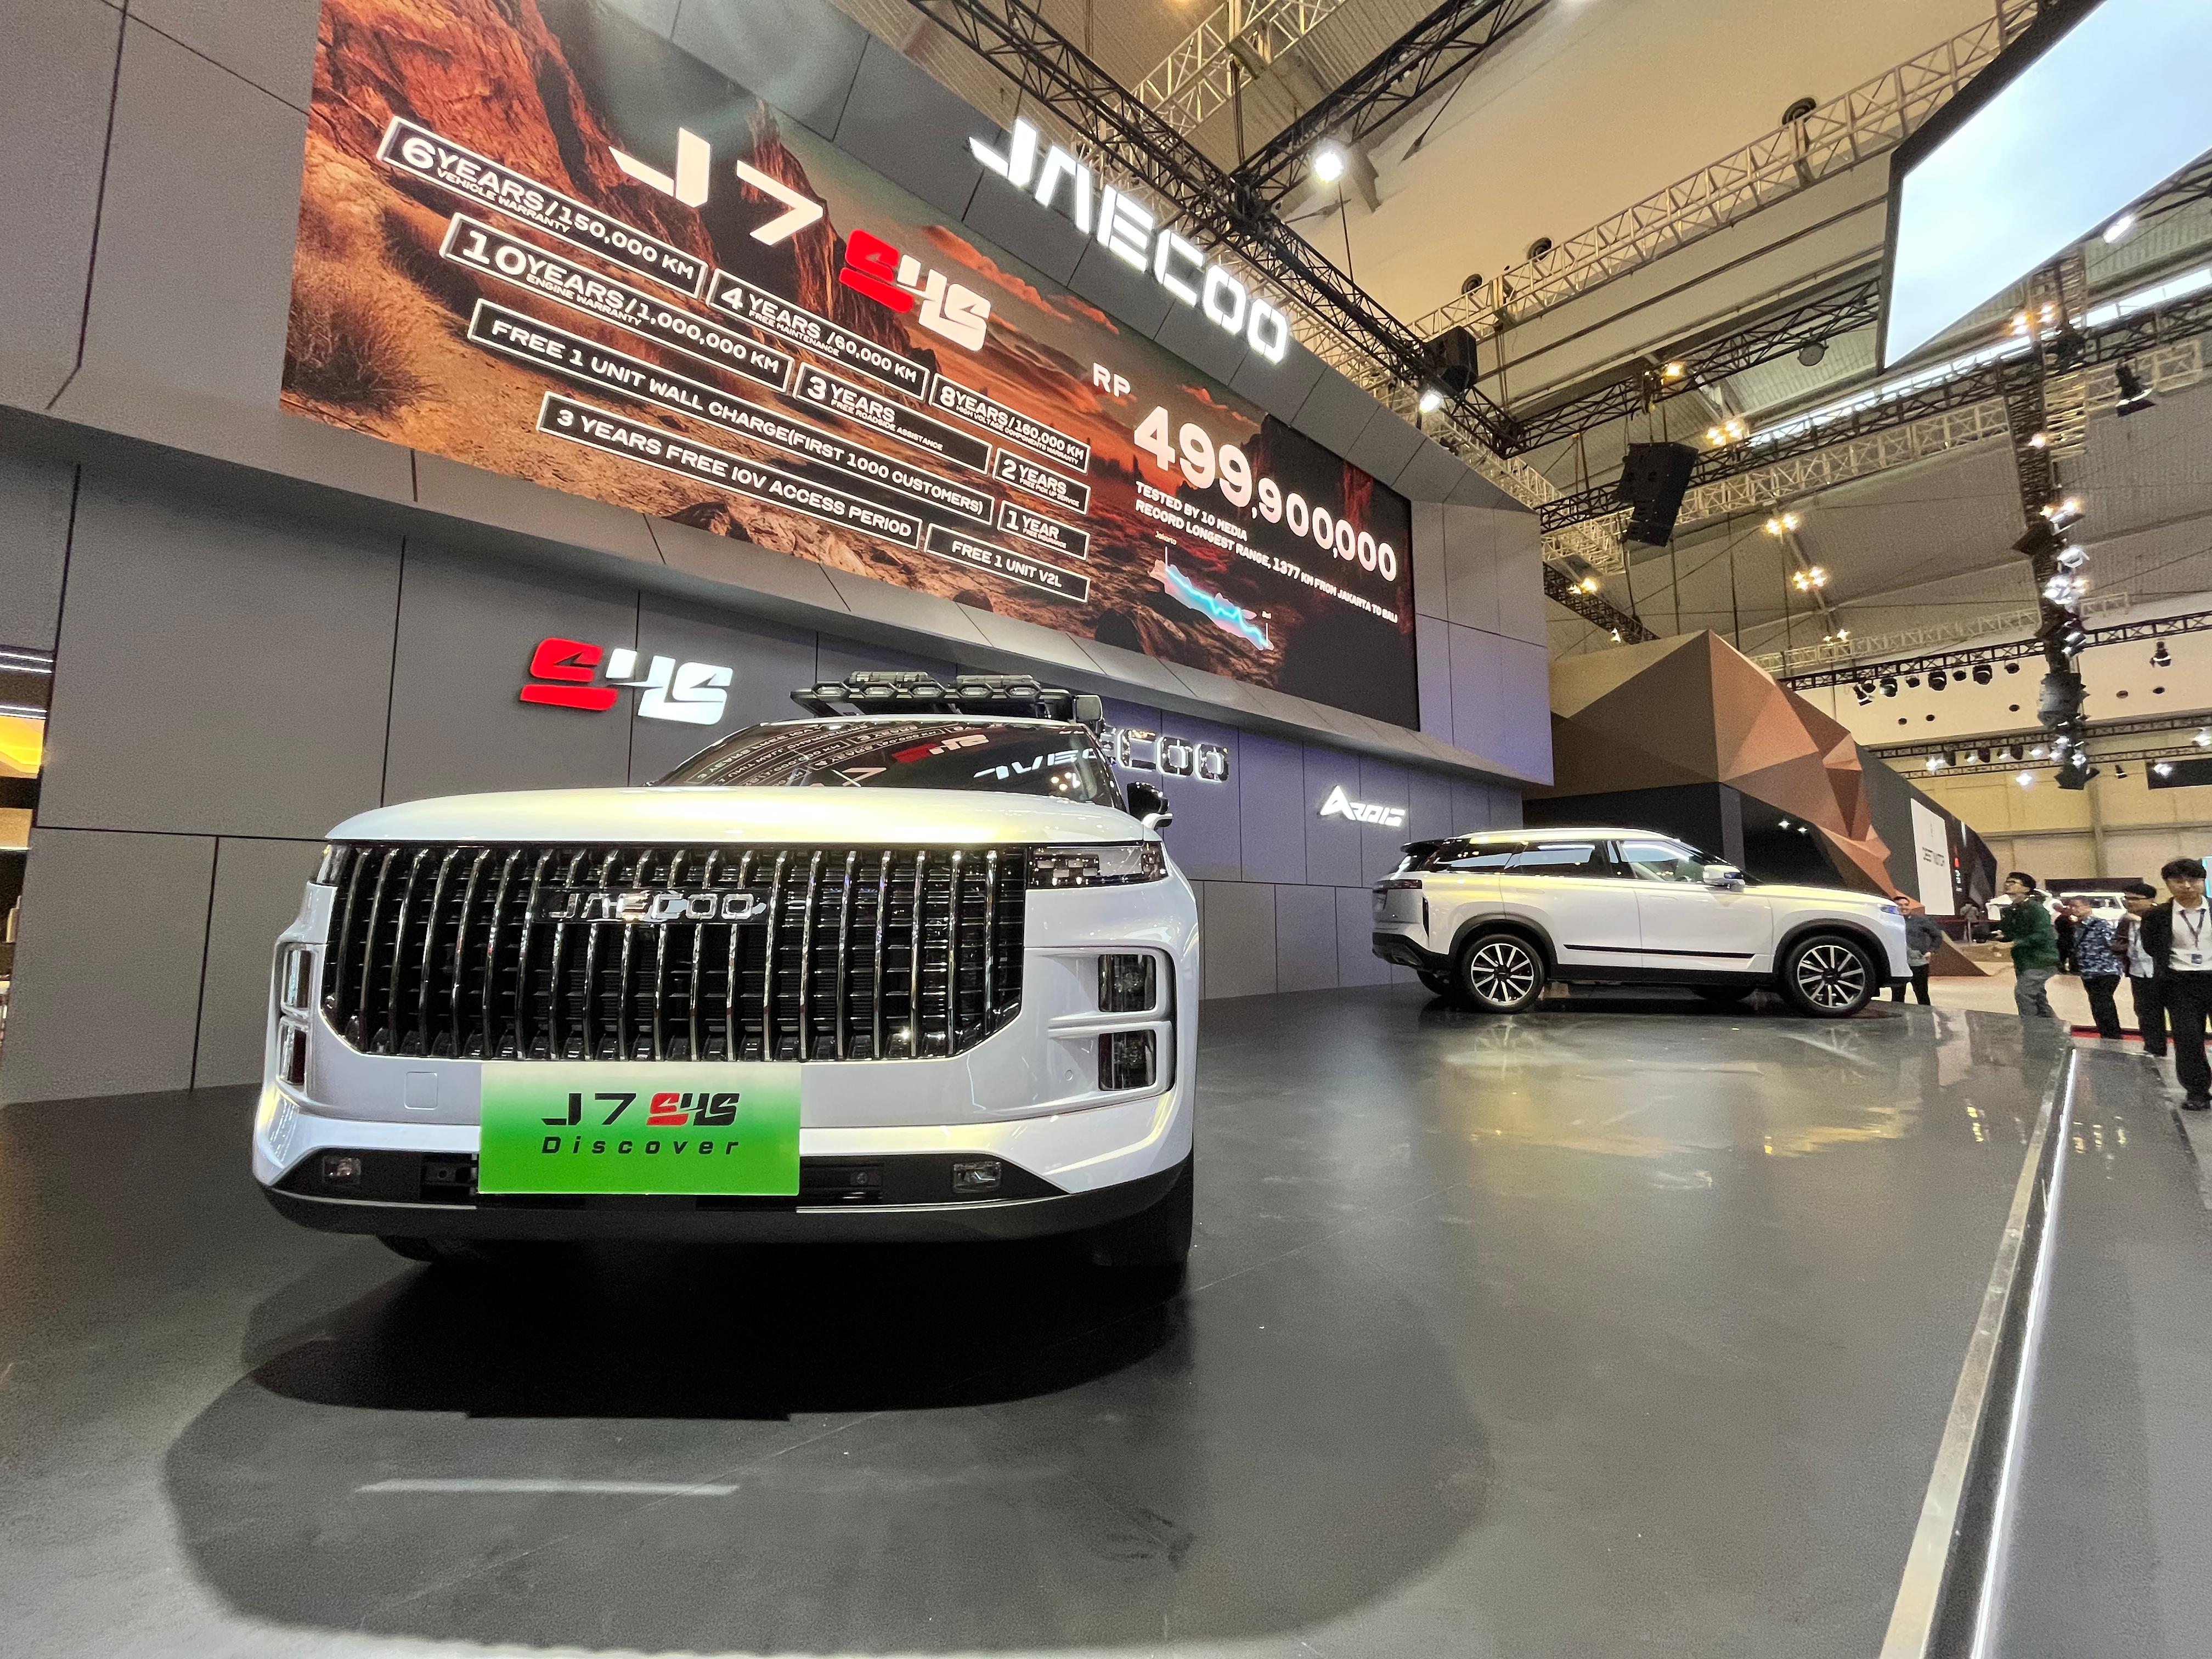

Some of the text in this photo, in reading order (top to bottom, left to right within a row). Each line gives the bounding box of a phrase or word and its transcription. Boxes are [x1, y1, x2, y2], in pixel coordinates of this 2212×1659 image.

[437, 167, 571, 233] VEHICLE WARRANTY
[968, 116, 1289, 364] JAECOO
[662, 254, 694, 280] KM
[526, 273, 642, 326] ENGINE WARRANTY
[721, 287, 743, 311] 4
[749, 293, 822, 339] YEARS
[894, 363, 917, 383] KM
[749, 309, 840, 357] FREE MAINTENANCE
[750, 351, 779, 374] KM
[1093, 362, 1131, 397] RP
[492, 319, 566, 359] FREE
[569, 349, 584, 367] 1
[591, 357, 646, 387] UNIT
[648, 378, 703, 411] WALL
[847, 453, 889, 479] 1000
[892, 471, 984, 516] CUSTOMERS)
[807, 376, 895, 424] 3 YEARS
[831, 399, 944, 452] FREE ROADSIDE ASSISTANCE
[956, 404, 973, 417] HIGH
[973, 413, 1005, 432] VOLTAGE
[1046, 446, 1079, 465] WARRANTY
[557, 409, 912, 537] 3 YEARS FREE IOV ACCESS PERIOD
[1066, 444, 1085, 461] KM
[1002, 459, 1068, 495] 2 YEARS
[1006, 510, 1060, 540] 1 YEAR
[1136, 481, 1248, 542] TESTED BY 10 MEDIA
[952, 540, 1063, 588] FREE 1 UNIT V2L
[1135, 499, 1398, 624] RECORD LONGEST RANGE, 1377 KM FROM JAKARTA TO BALI
[520, 637, 734, 725] SHS
[549, 892, 754, 920] JAECOO
[646, 1093, 740, 1126] SHS
[541, 1136, 739, 1155] Discover
